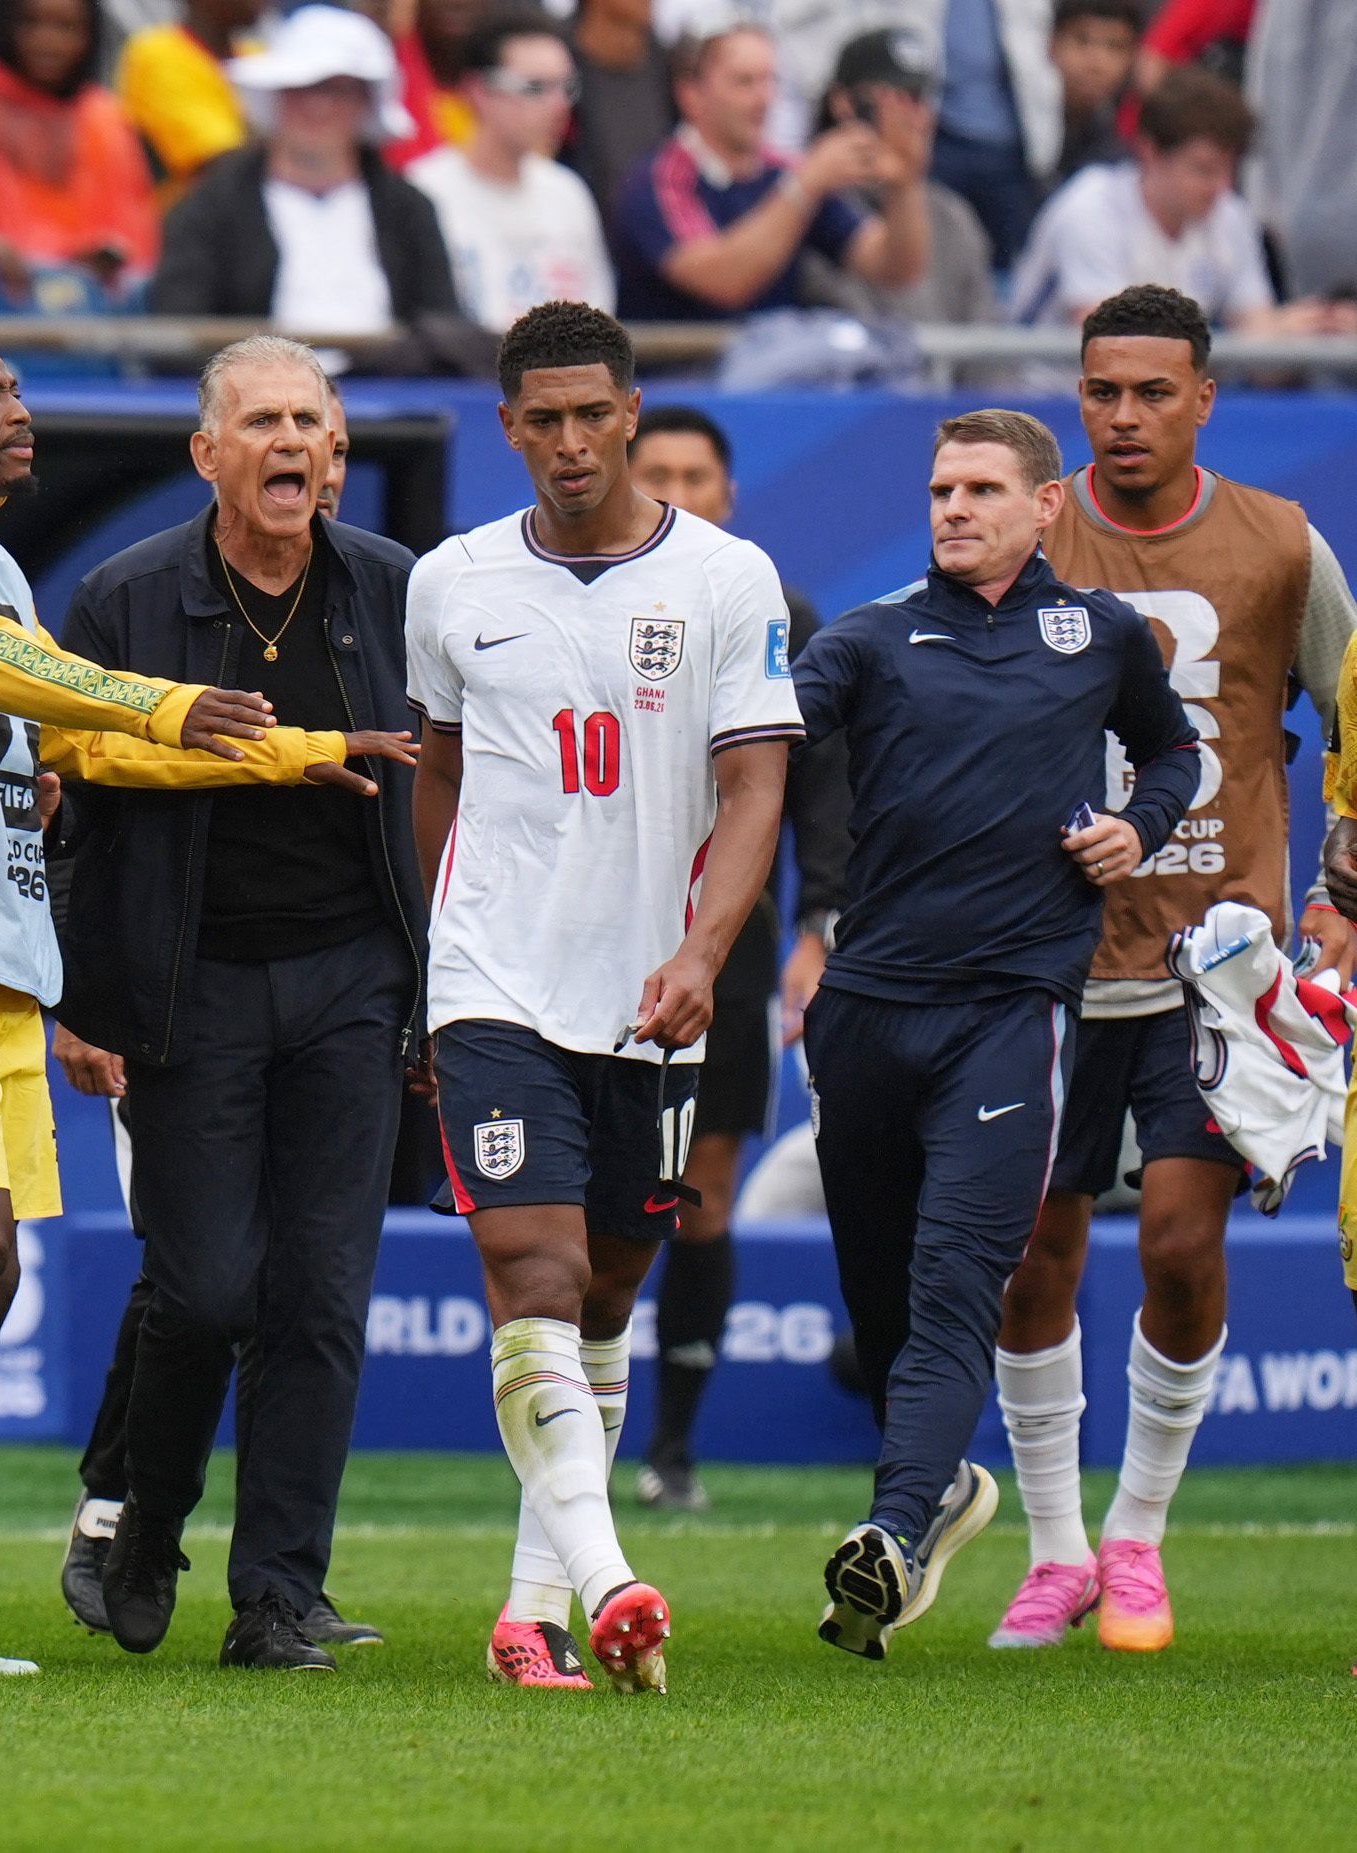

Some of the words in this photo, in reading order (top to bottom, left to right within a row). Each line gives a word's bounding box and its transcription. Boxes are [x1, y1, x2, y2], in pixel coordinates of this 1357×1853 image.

[636, 686, 665, 699] GHANA
[552, 709, 620, 797] 10
[1175, 819, 1224, 839] CUP
